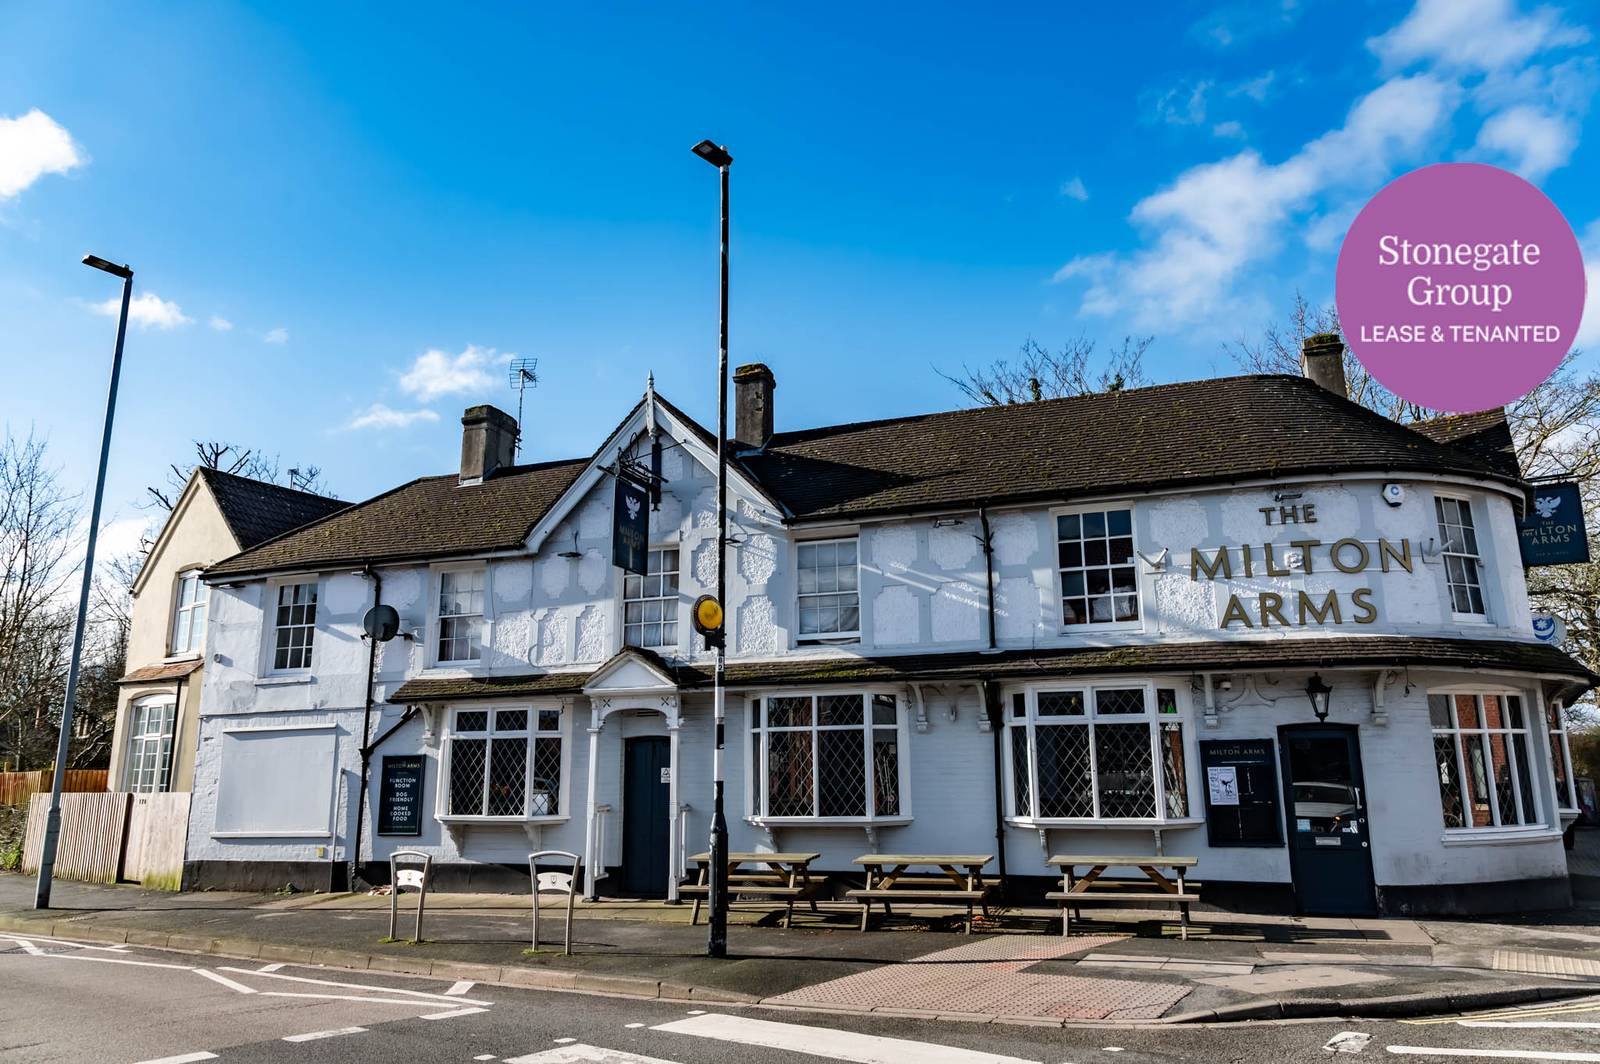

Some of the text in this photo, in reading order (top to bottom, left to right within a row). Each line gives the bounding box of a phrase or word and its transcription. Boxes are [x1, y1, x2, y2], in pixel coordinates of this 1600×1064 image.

[1258, 503, 1318, 526] THE
[1532, 533, 1570, 545] ARMS
[1190, 537, 1413, 581] MILTON
[1220, 588, 1377, 628] ARMS
